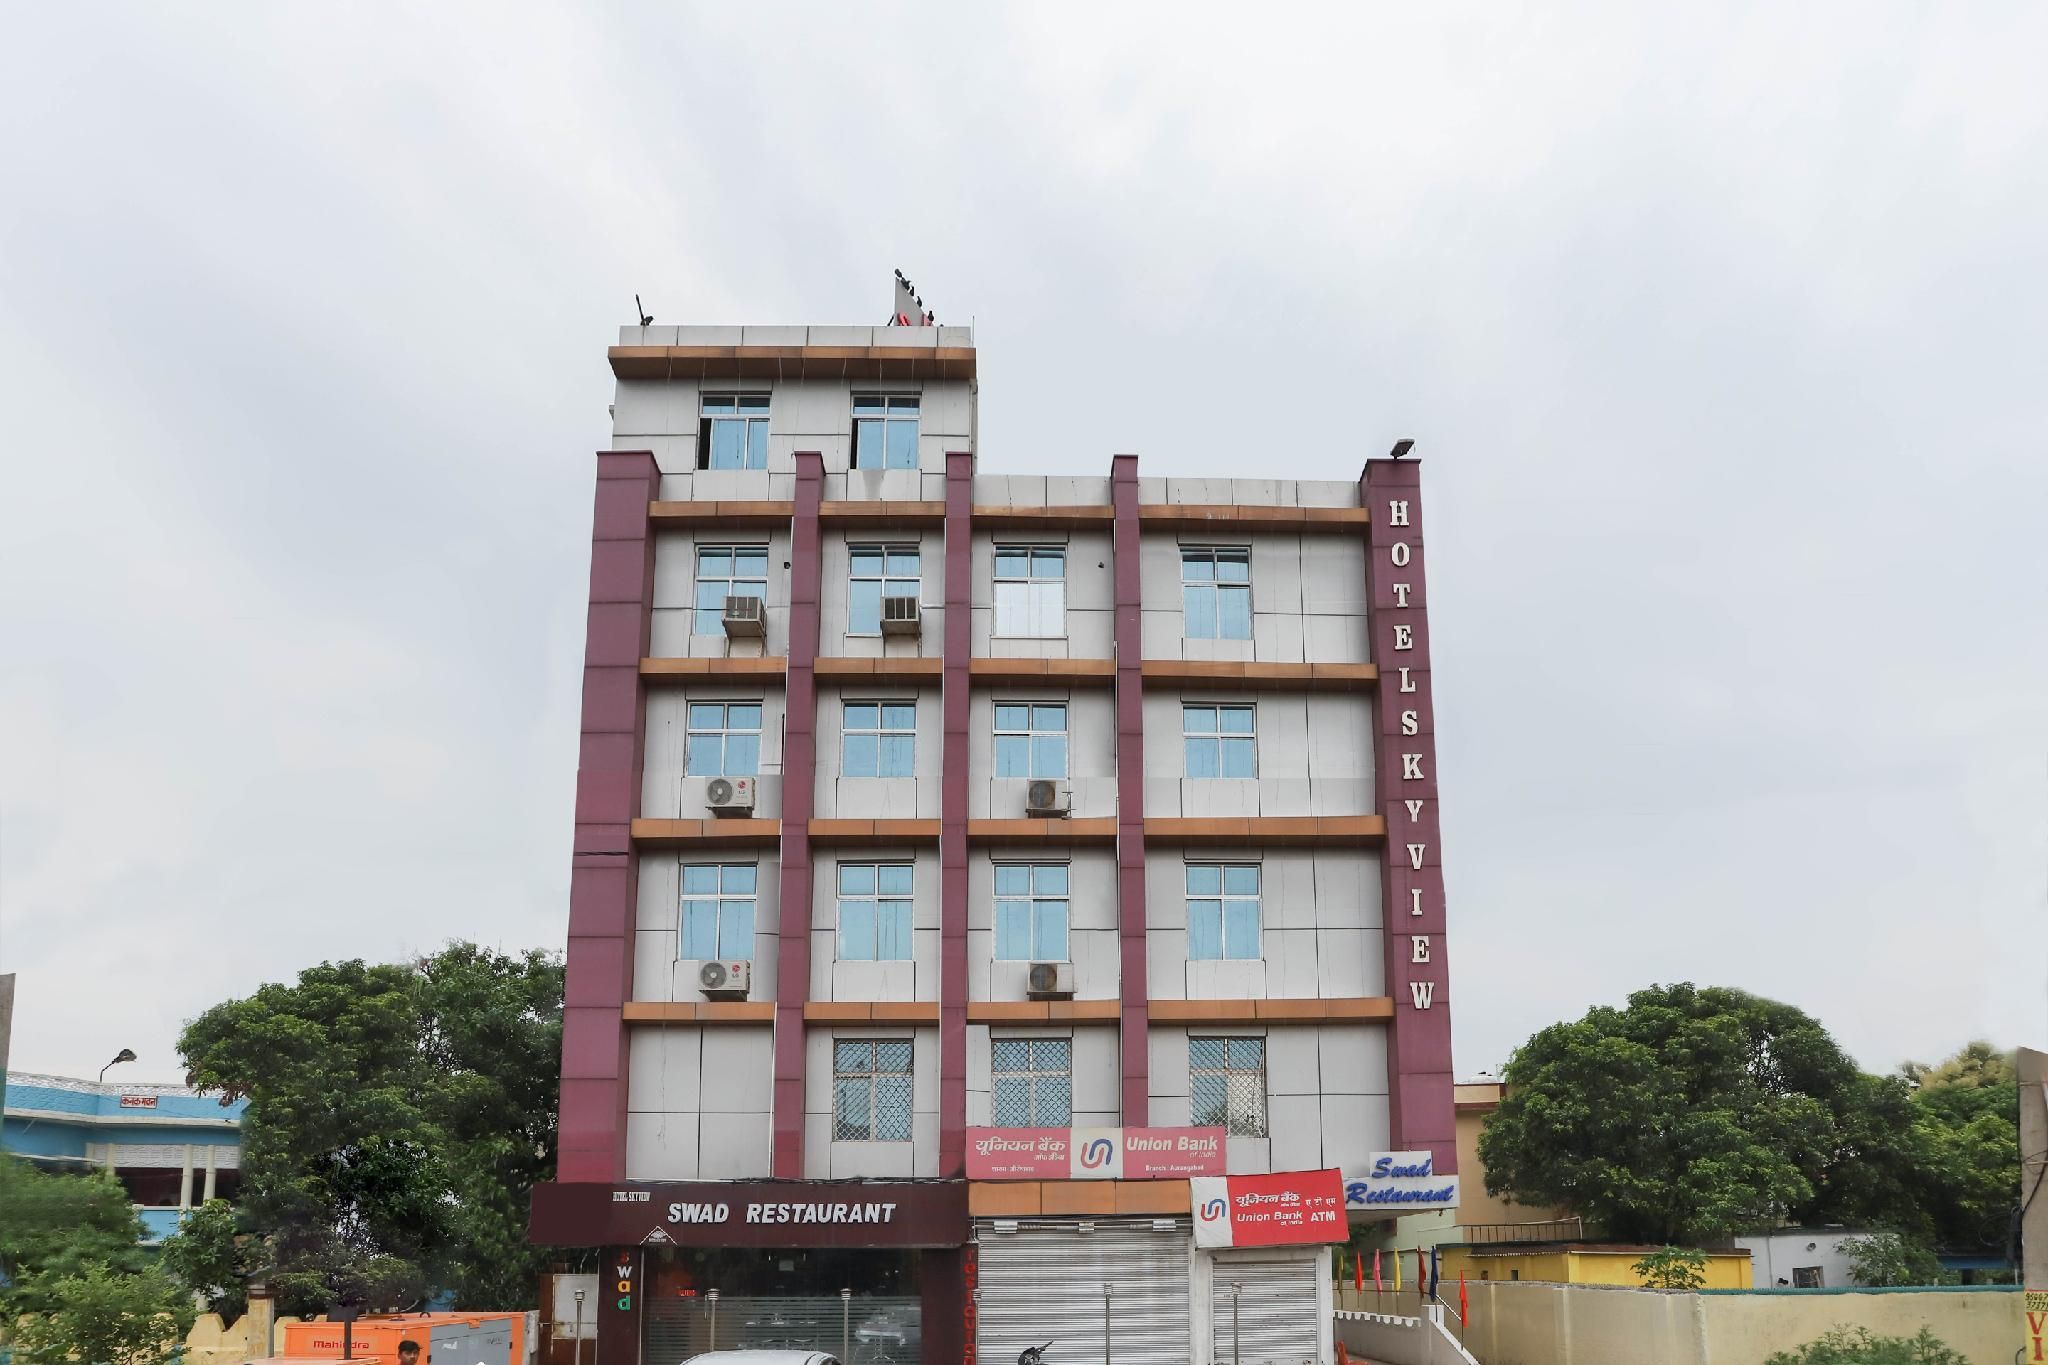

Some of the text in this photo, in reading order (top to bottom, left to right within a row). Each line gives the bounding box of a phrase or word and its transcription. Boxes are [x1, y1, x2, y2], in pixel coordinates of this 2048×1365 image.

[976, 1136, 1068, 1156] यूनियन बैंक
[1126, 1136, 1218, 1151] Union Bank
[1371, 1157, 1431, 1179] Swad
[1235, 1191, 1301, 1207] यूनियन बैंक
[1346, 1182, 1454, 1204] Restaurant
[667, 1203, 897, 1223] SWAD RESTAURANT
[1237, 1211, 1303, 1222] Union Bank
[1310, 1211, 1336, 1222] ATM
[313, 1341, 369, 1349] Mahidra
